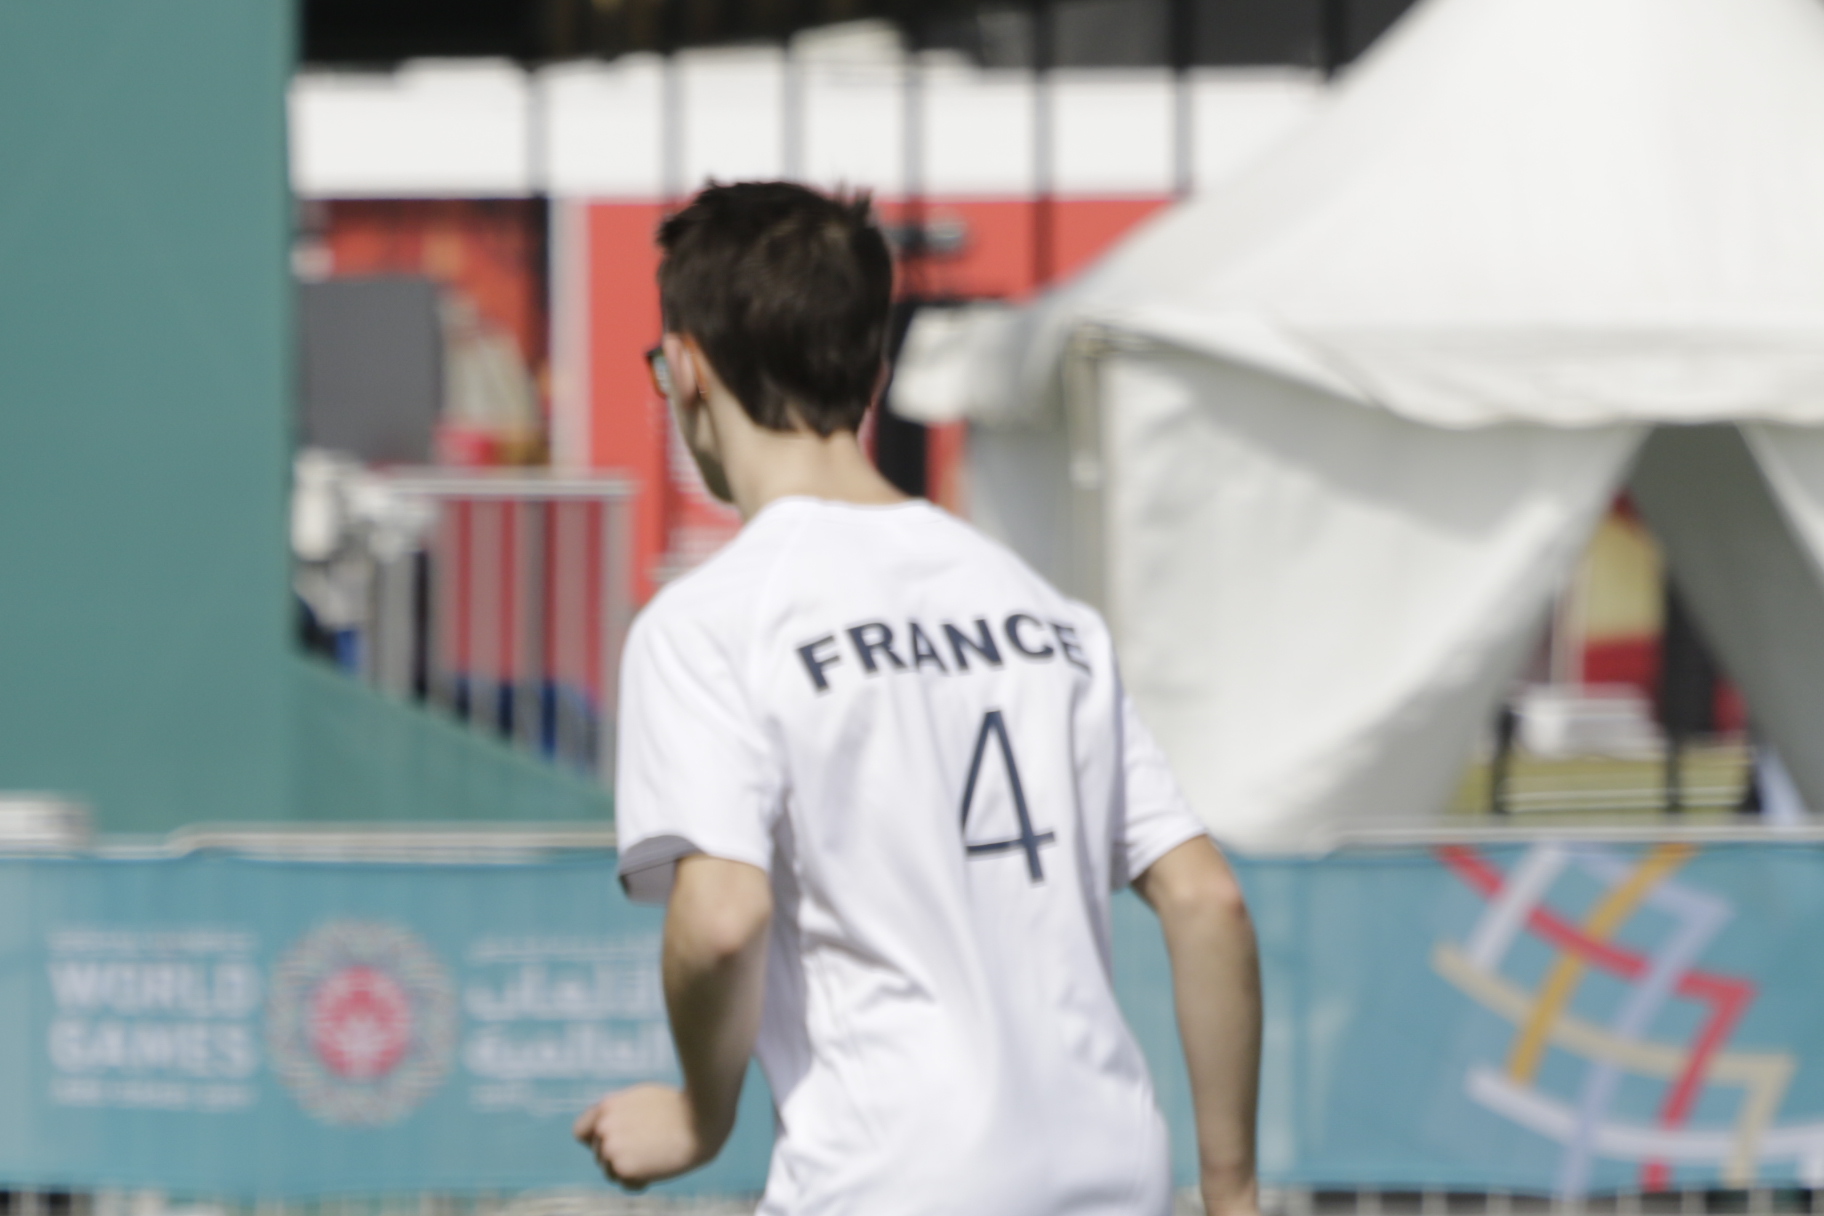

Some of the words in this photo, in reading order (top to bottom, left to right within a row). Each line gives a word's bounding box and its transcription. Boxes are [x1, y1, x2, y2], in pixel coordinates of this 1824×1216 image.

[797, 611, 1092, 695] FRANCE
[962, 708, 1056, 884] 4
[48, 961, 262, 1018] WORLD
[49, 1018, 260, 1078] GAMES
